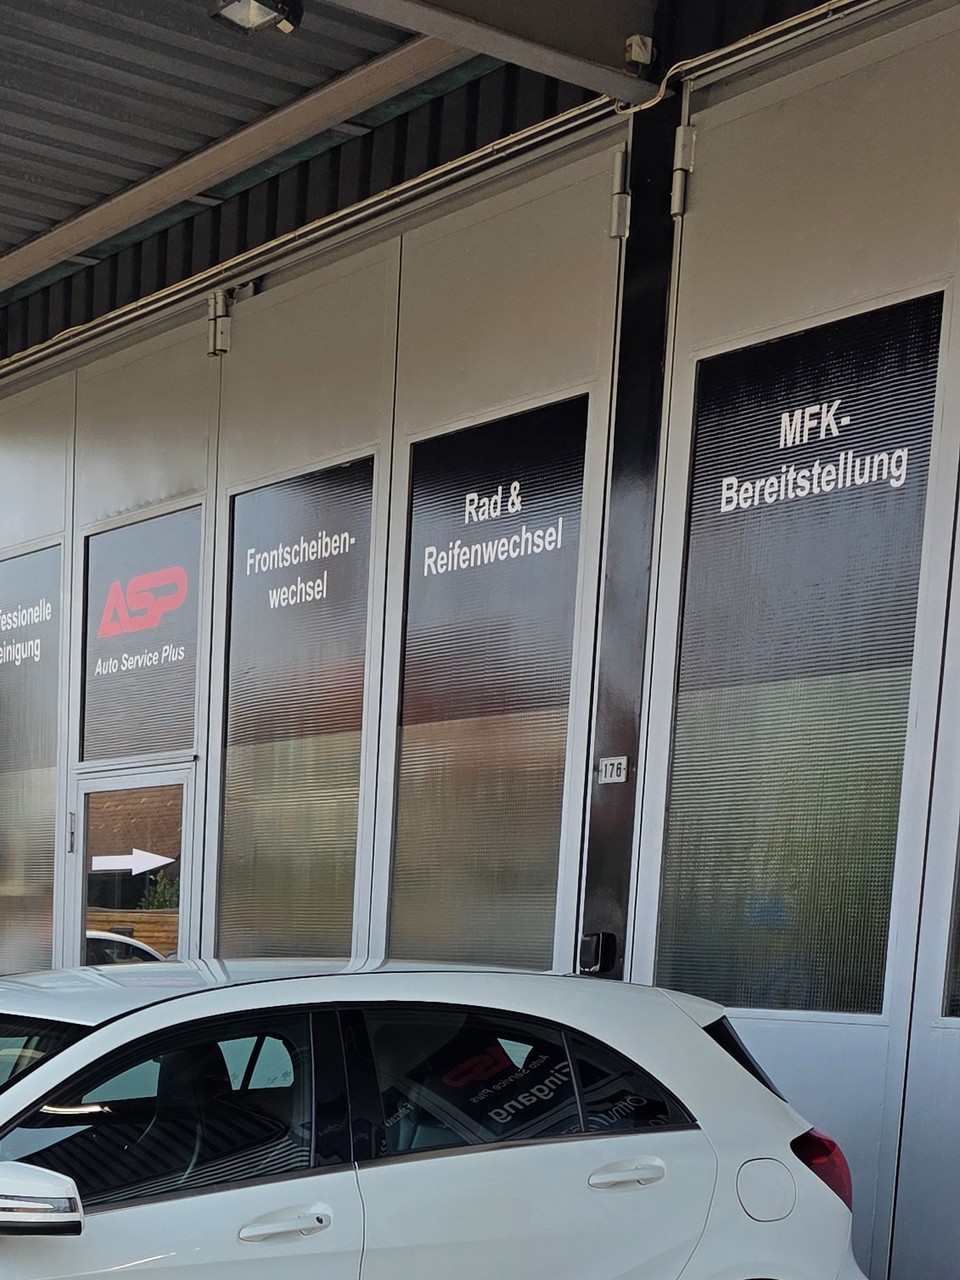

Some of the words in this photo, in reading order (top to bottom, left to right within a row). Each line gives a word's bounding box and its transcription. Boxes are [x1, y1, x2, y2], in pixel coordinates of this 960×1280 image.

[779, 399, 851, 449] MFK-
[720, 447, 909, 513] Bereitstellung
[464, 485, 502, 524] Rad
[507, 481, 523, 514] &
[246, 531, 356, 575] Frontscheiben-
[423, 517, 564, 577] Reifenwechsel
[96, 565, 188, 639] ASP
[268, 570, 328, 609] wechsel
[94, 656, 118, 676] Auto
[121, 650, 159, 672] Service
[160, 643, 186, 663] Plus
[603, 762, 623, 779] 176
